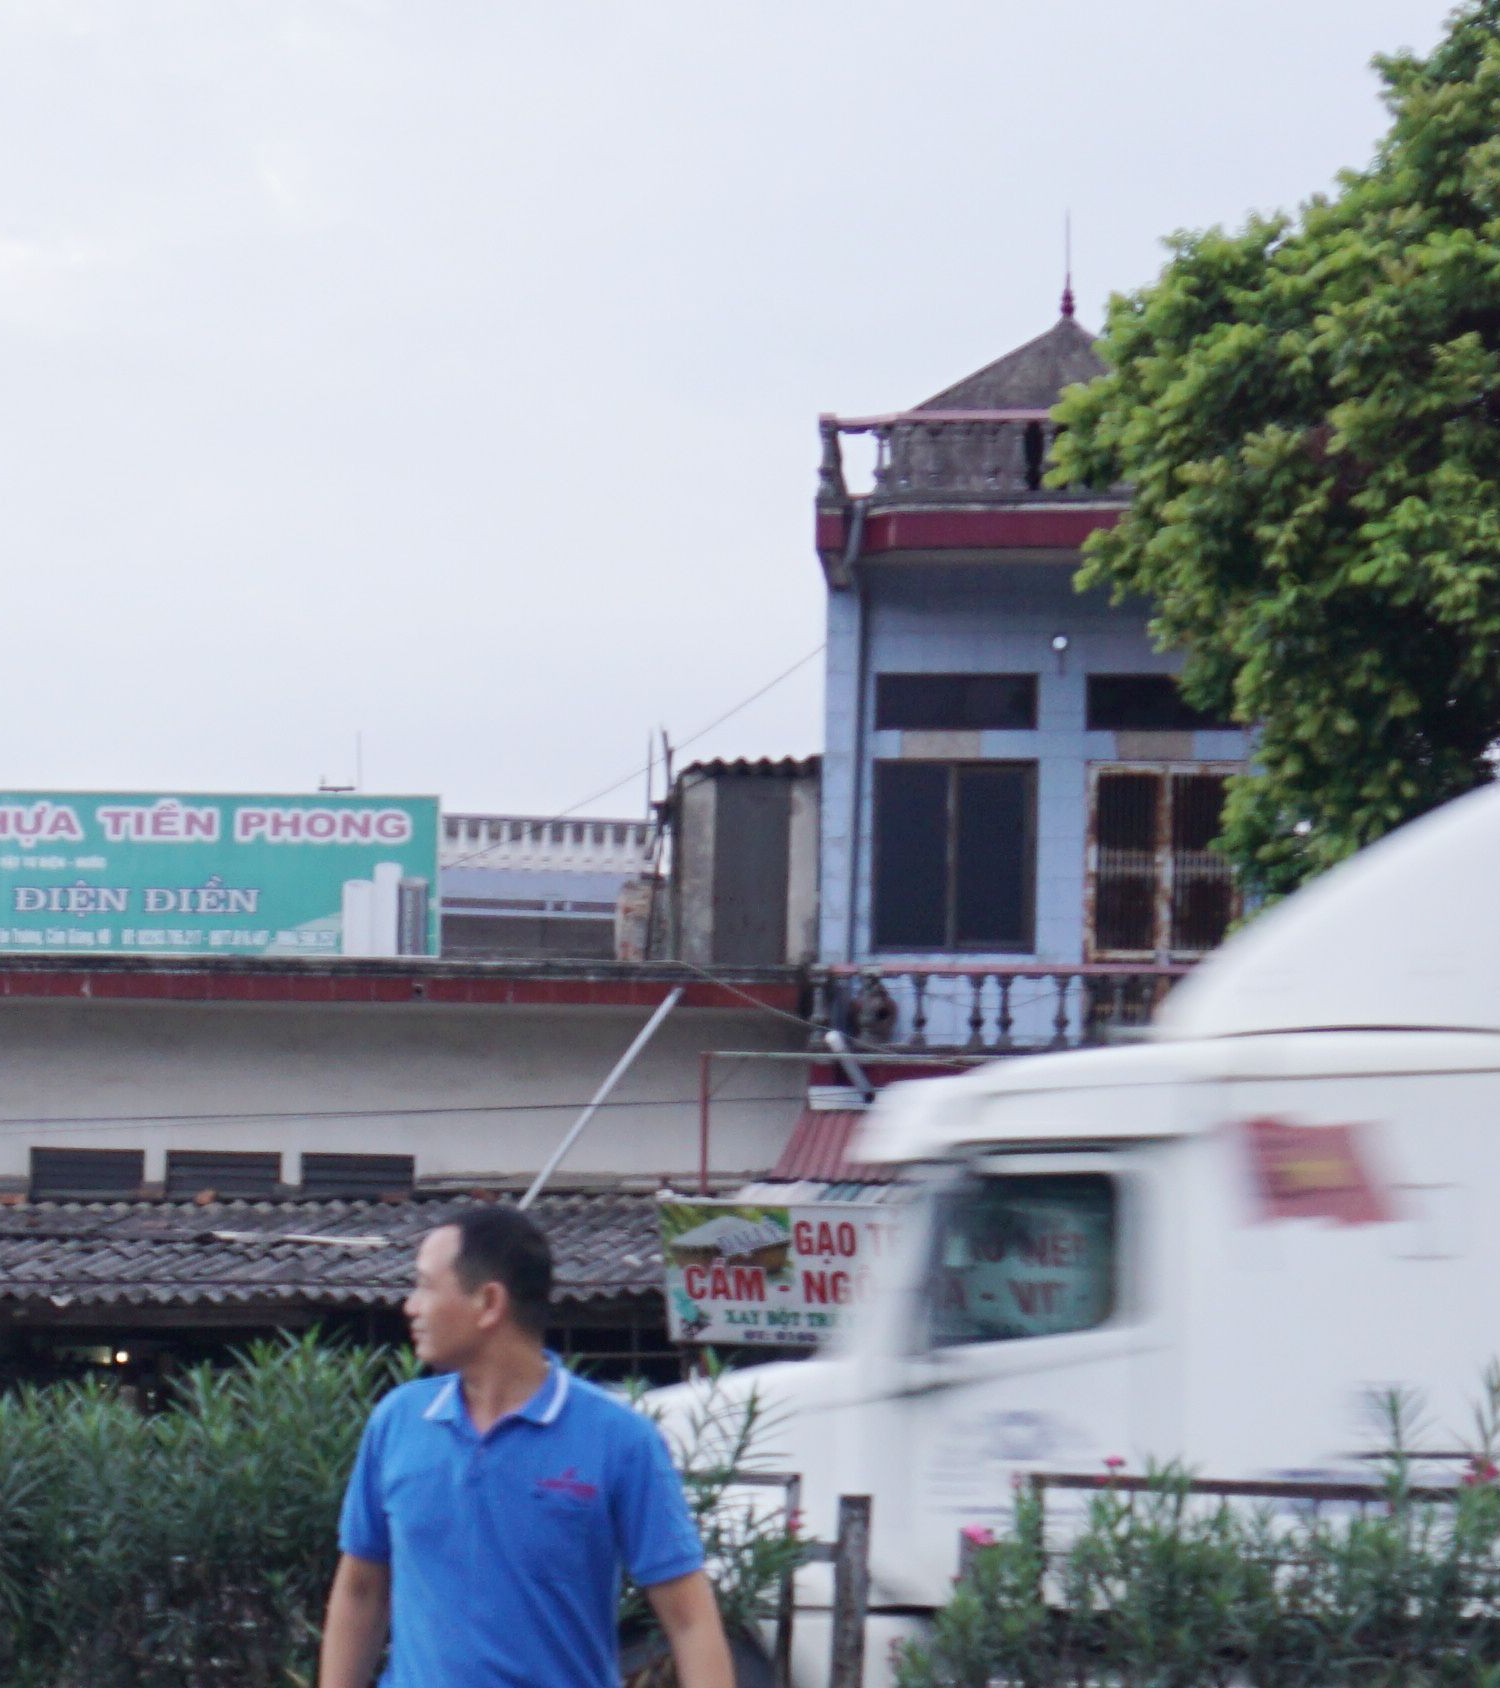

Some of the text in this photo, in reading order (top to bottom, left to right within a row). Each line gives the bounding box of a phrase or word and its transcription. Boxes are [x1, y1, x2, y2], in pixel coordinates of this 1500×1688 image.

[100, 802, 216, 838] TIỀN
[240, 811, 409, 839] PHONG
[14, 879, 130, 917] ĐIỆN
[793, 1220, 857, 1264] GẠO
